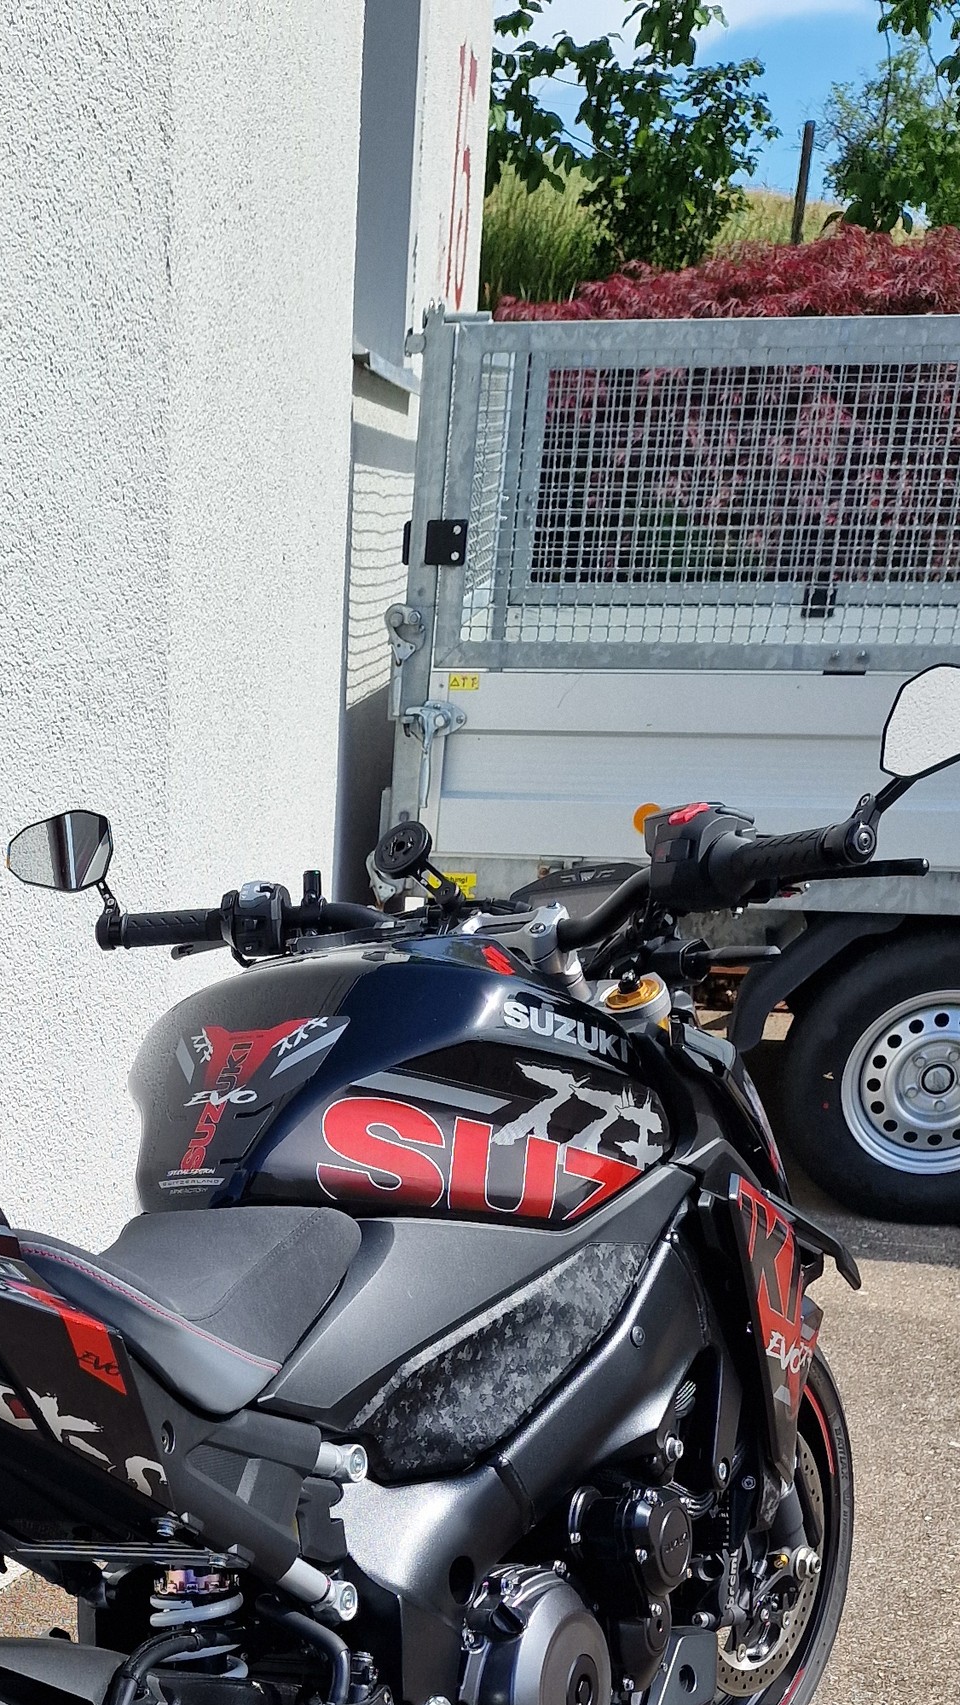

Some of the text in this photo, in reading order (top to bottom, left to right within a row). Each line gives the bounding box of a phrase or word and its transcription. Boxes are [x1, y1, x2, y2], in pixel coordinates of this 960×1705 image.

[503, 1000, 630, 1064] SUZUKI
[183, 1084, 259, 1108] EVO
[79, 1351, 122, 1377] EVO
[766, 1331, 801, 1375] EVO
[725, 1548, 740, 1610] brem
